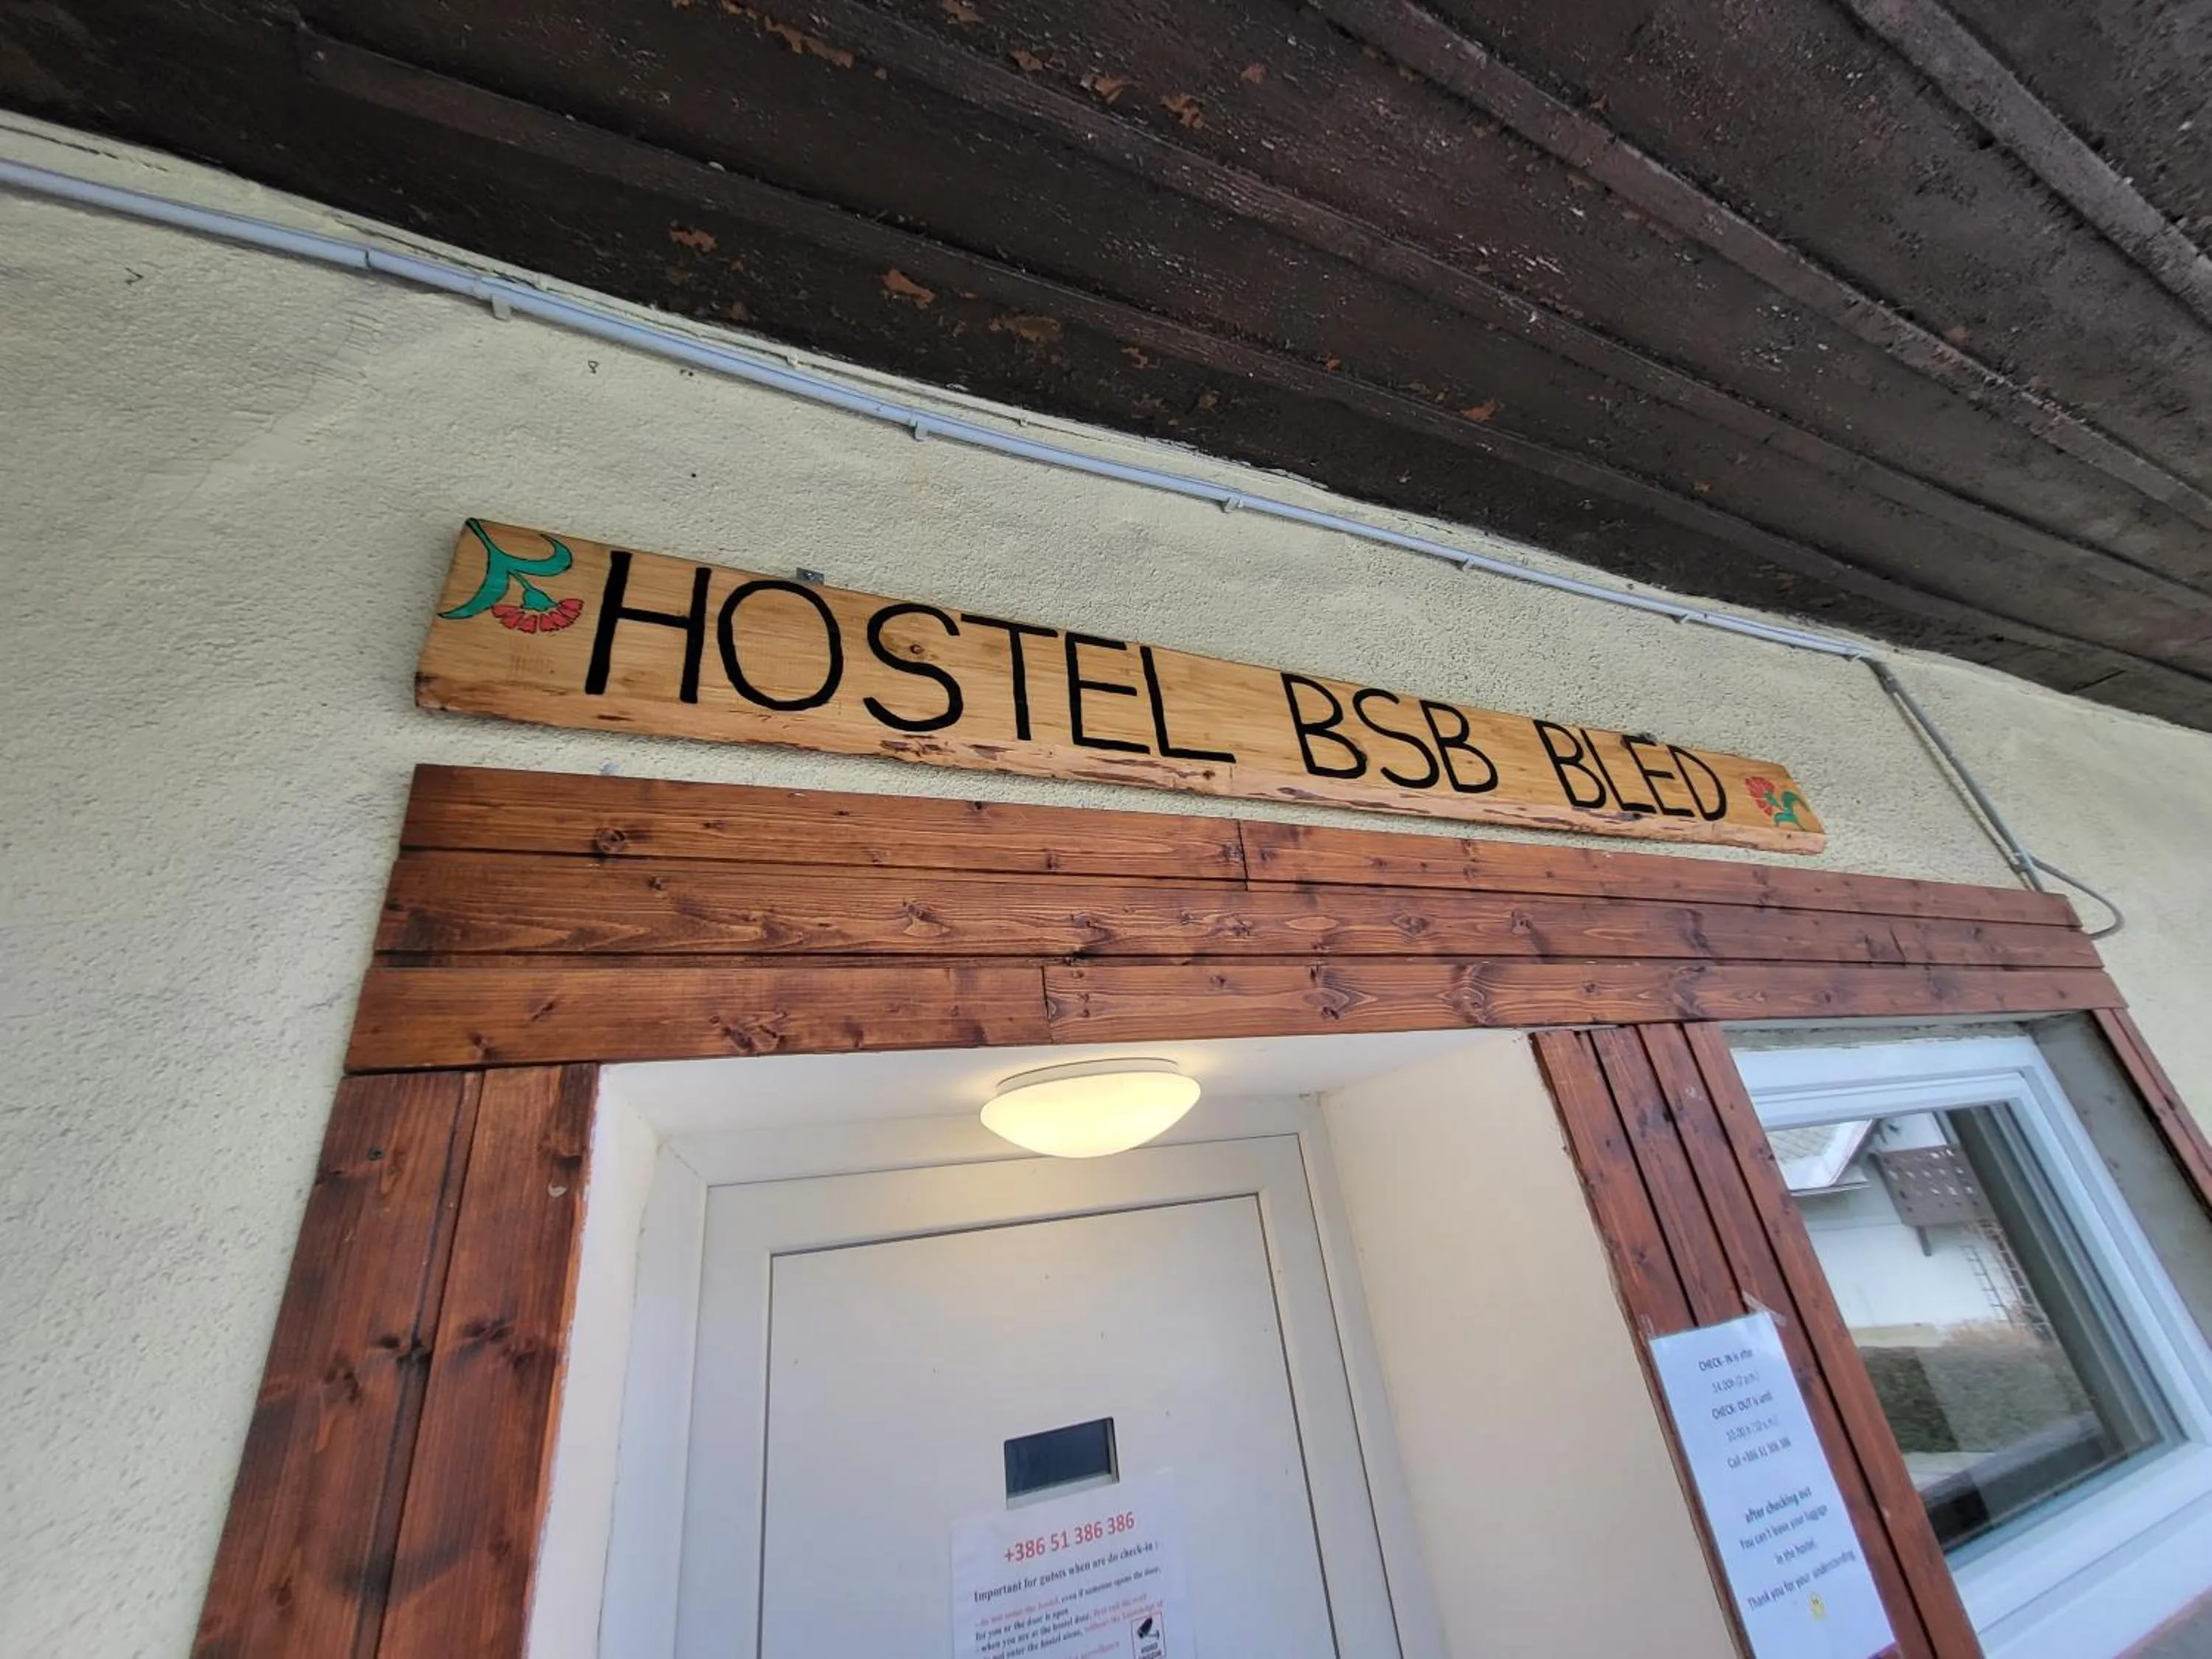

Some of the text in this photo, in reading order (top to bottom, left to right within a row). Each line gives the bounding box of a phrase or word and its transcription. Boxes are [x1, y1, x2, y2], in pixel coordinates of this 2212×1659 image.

[585, 551, 1728, 821] HOSTEL BSB BLED
[1766, 1493, 1799, 1514] checking
[1004, 1512, 1135, 1562] +386 51 386 386
[974, 1580, 1021, 1604] Important
[1023, 1576, 1037, 1589] for
[1068, 1562, 1091, 1575] when
[1092, 1557, 1105, 1569] are
[1107, 1551, 1119, 1563] do
[1062, 1591, 1077, 1604] even
[988, 1627, 1002, 1639] you
[1014, 1620, 1025, 1631] the
